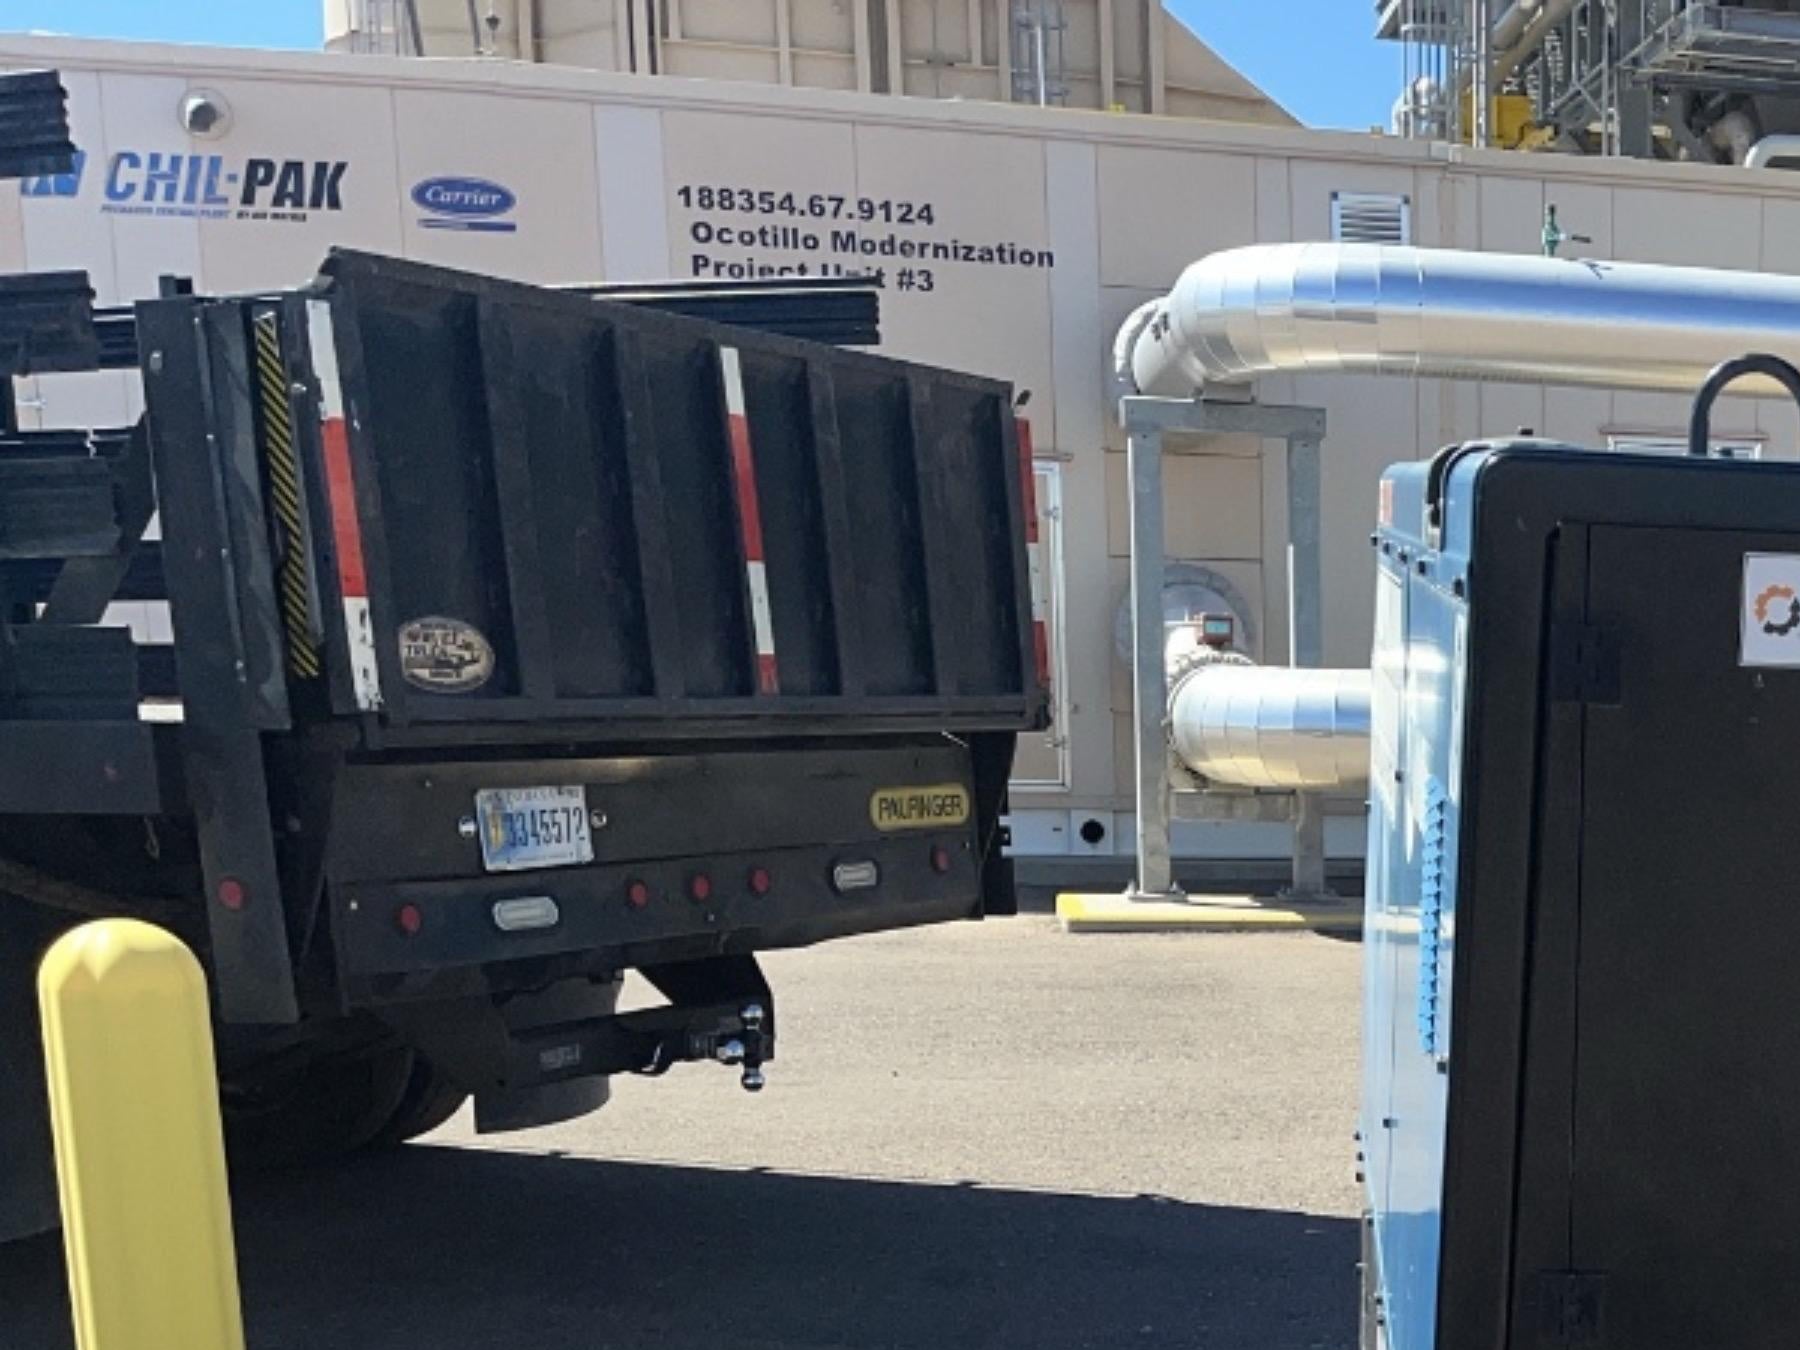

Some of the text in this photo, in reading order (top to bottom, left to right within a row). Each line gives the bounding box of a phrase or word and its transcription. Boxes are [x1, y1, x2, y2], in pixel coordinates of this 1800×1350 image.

[424, 184, 502, 206] Carrier
[677, 185, 935, 226] 188354.67.9124
[690, 221, 1056, 268] Ocotillo Modernization
[897, 268, 935, 293] #3
